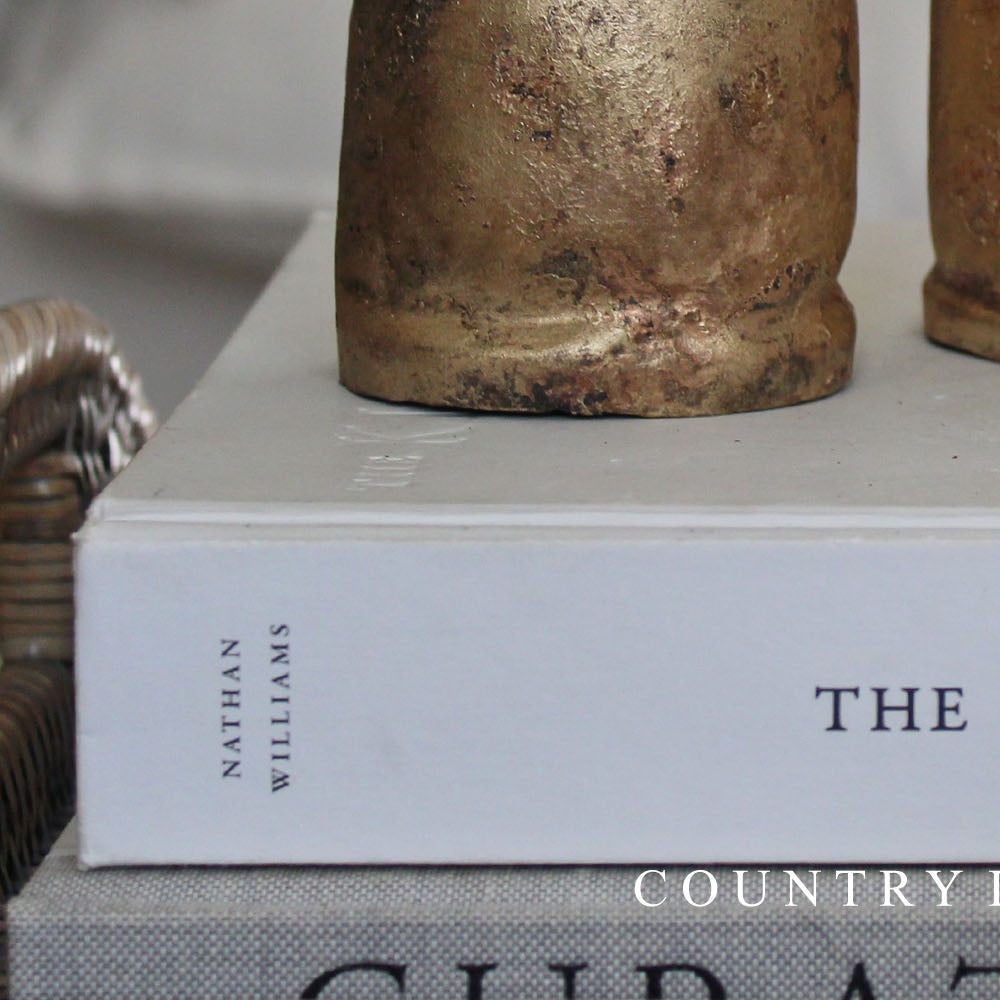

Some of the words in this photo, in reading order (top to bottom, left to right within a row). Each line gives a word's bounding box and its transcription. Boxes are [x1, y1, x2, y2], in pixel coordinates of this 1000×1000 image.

[220, 638, 241, 778] NATHAN
[269, 623, 291, 793] WILLIAMS
[814, 686, 968, 732] THE
